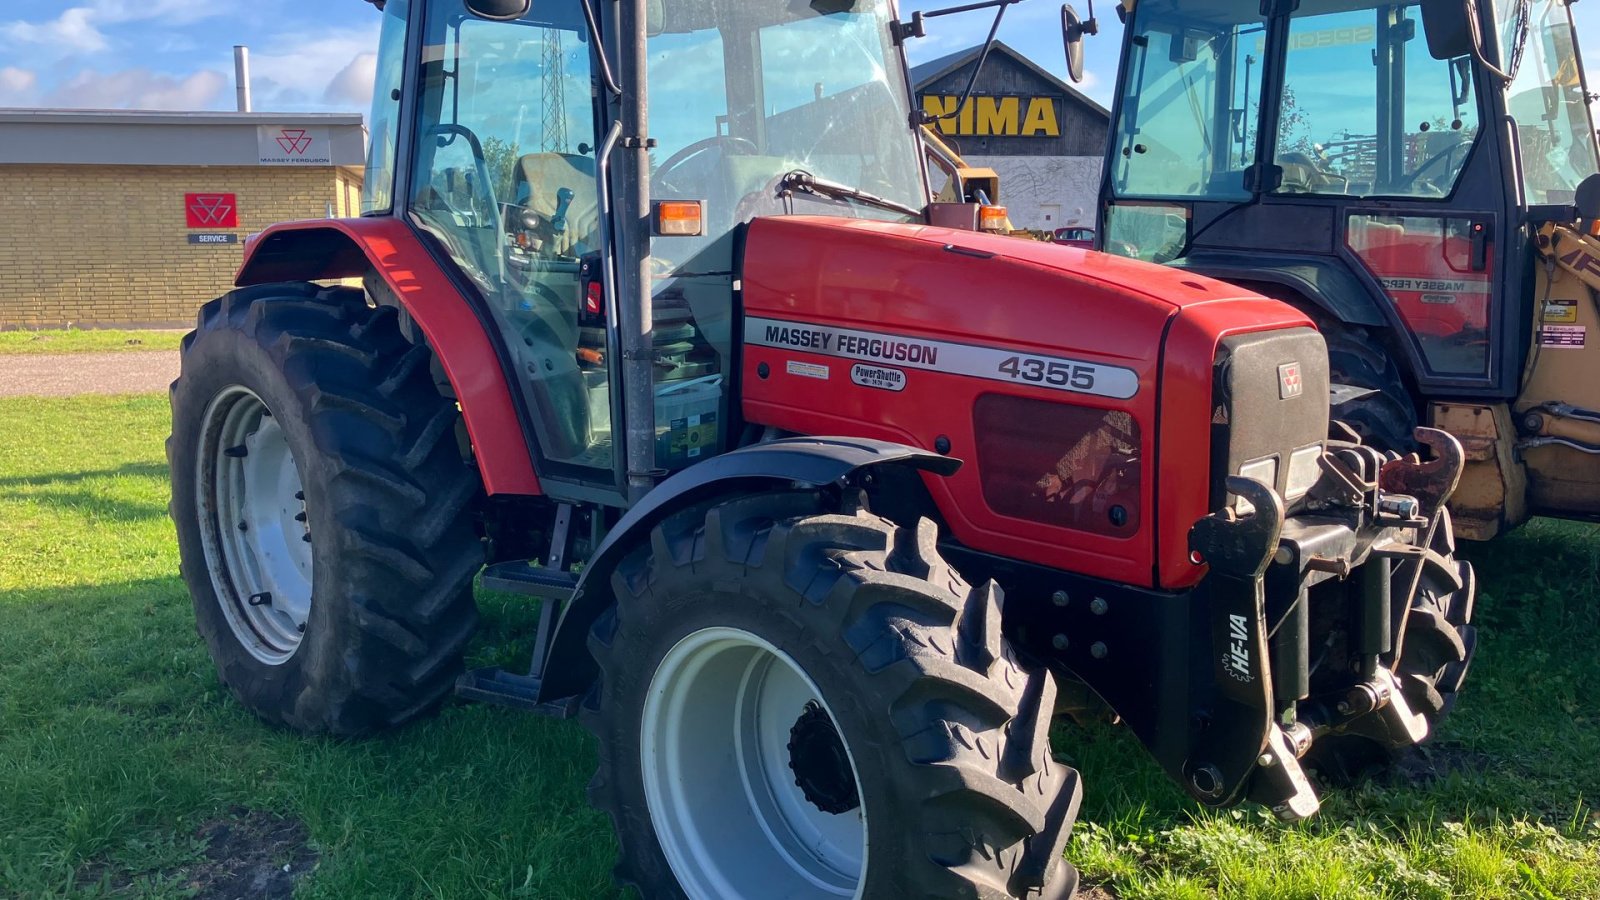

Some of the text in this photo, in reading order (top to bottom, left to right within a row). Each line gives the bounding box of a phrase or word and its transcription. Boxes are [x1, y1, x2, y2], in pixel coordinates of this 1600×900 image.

[923, 95, 1060, 136] NIMA
[198, 234, 228, 243] SERVICE
[765, 325, 938, 365] MASSEY FERGUSON
[855, 365, 901, 383] PowerShuttle
[998, 356, 1096, 390] 4355
[1229, 614, 1249, 675] HE-VA
